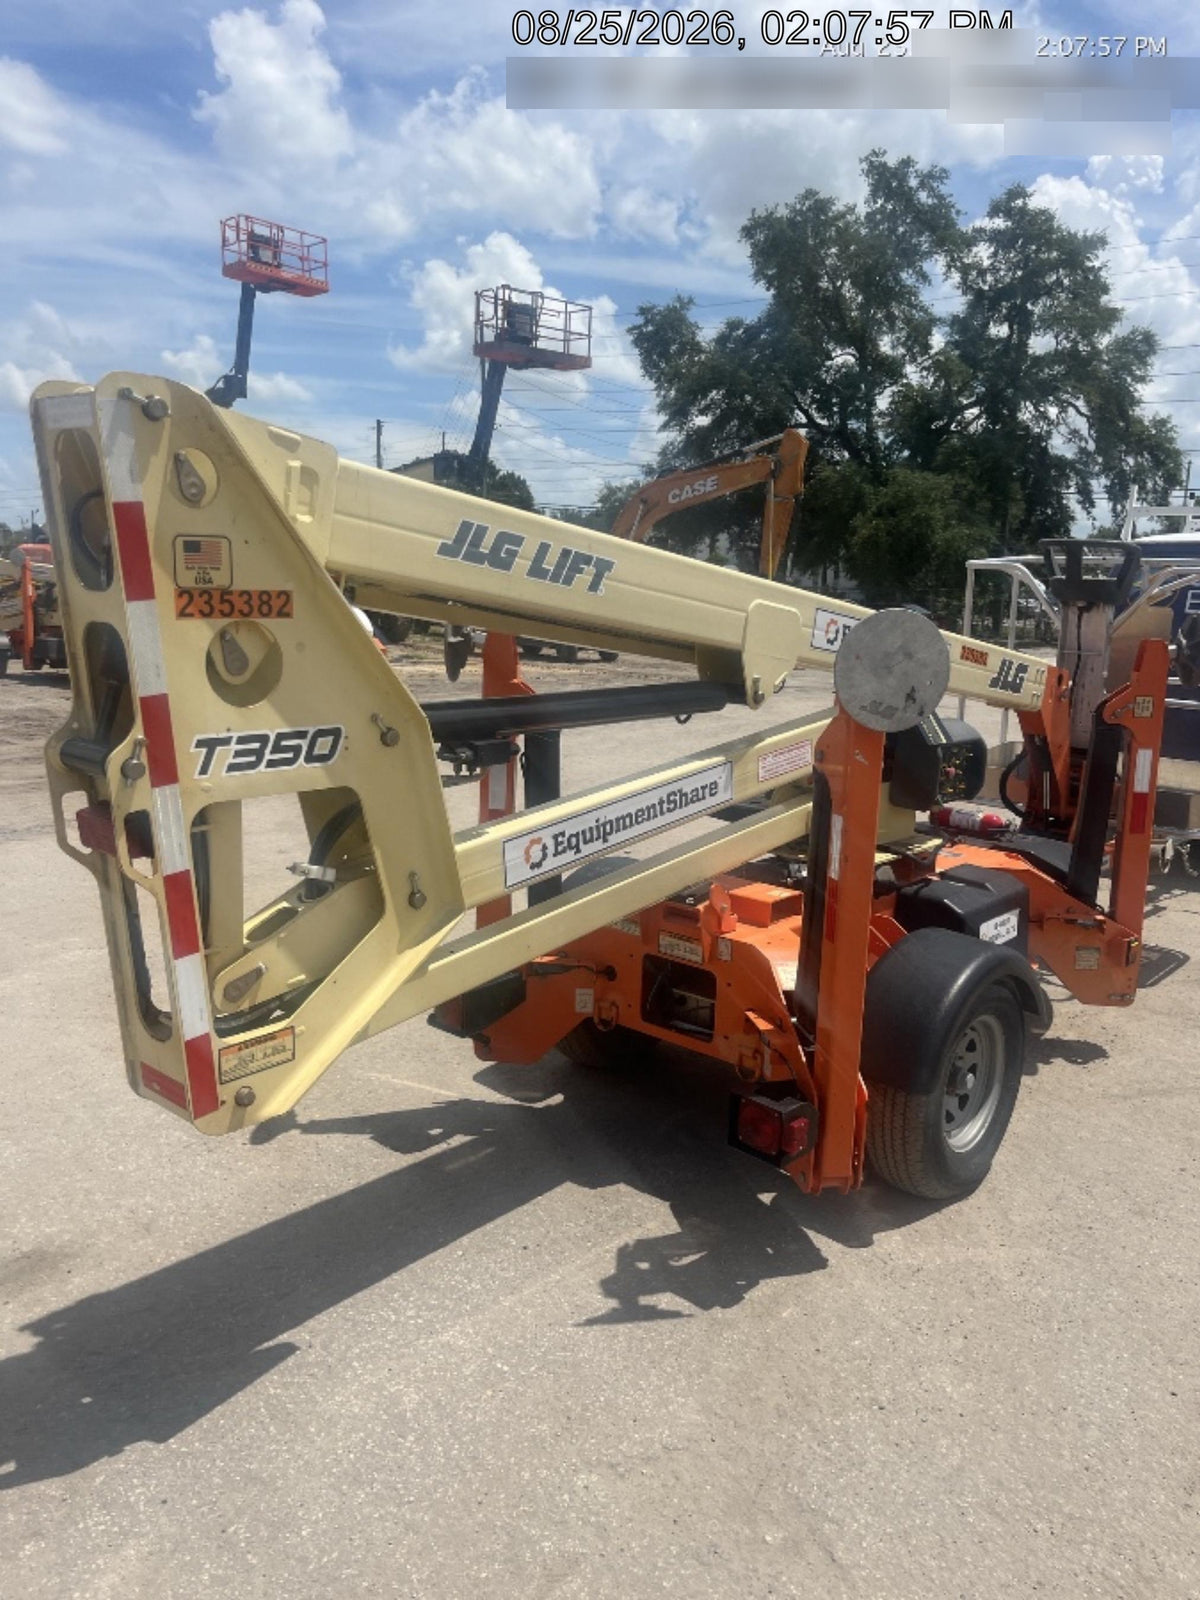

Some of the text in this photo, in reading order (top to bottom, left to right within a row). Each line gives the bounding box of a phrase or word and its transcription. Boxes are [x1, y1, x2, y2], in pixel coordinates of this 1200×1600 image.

[668, 474, 719, 503] CASE
[435, 519, 617, 595] JLG LIFT
[177, 590, 292, 618] 235382
[988, 657, 1030, 696] JLG
[190, 725, 346, 779] T350
[552, 779, 719, 857] EquipmentShare
